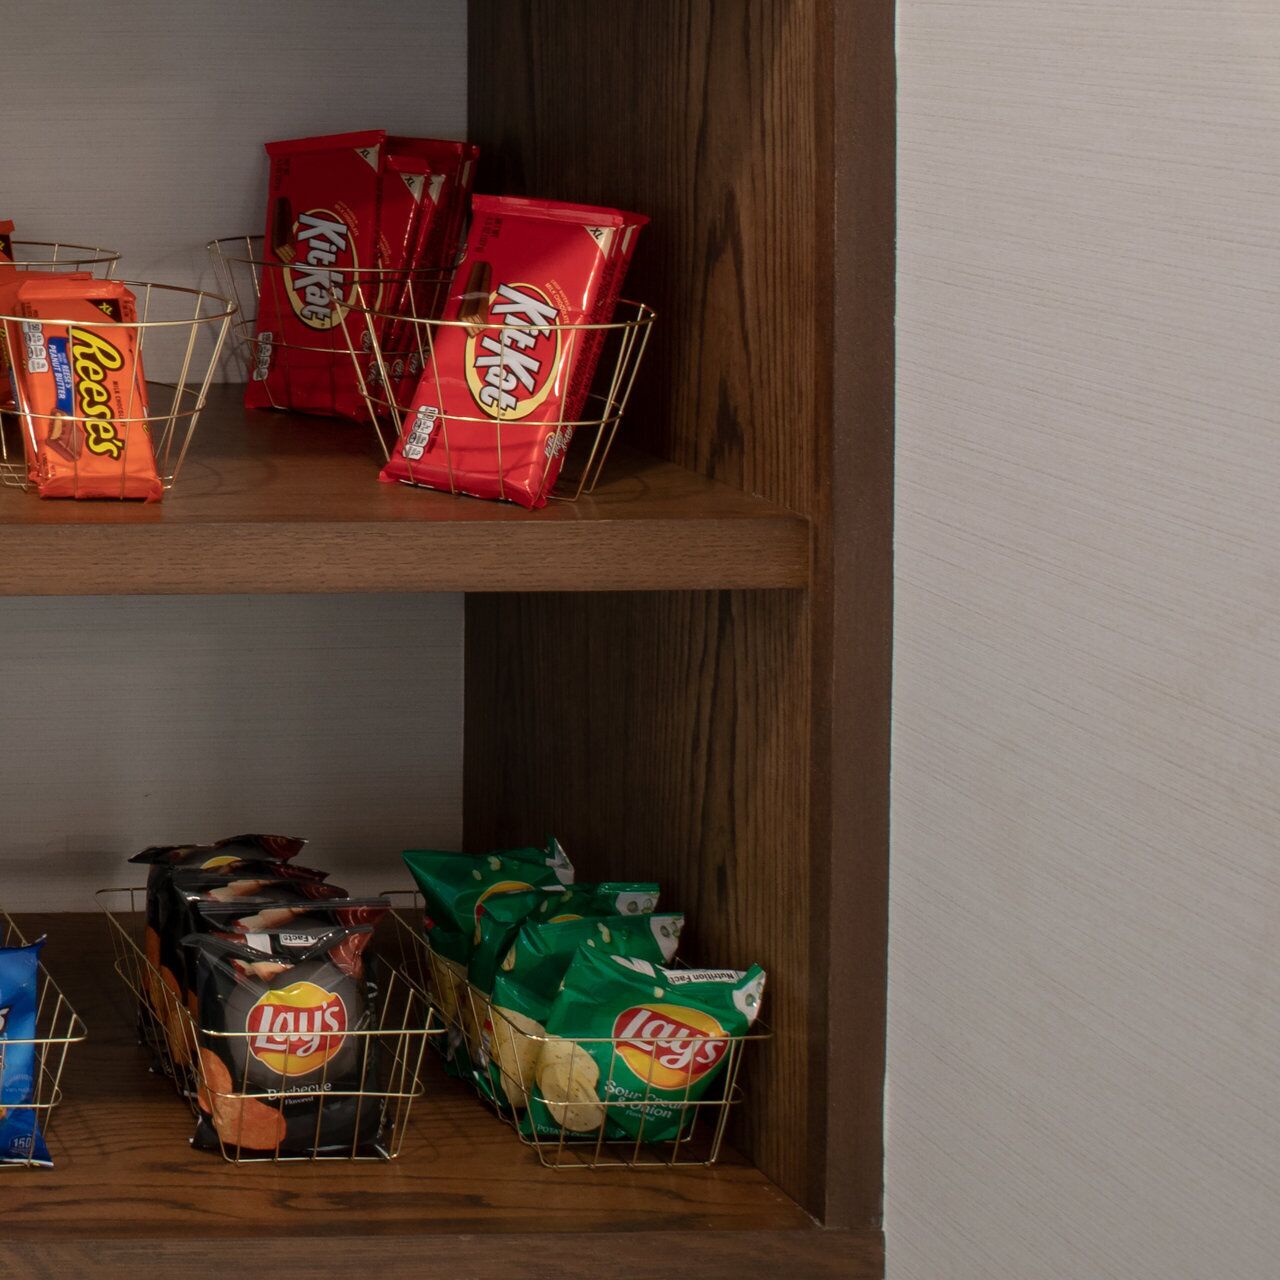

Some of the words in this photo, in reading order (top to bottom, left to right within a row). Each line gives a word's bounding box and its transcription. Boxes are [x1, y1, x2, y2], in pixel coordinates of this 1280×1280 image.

[297, 213, 349, 269] Kit
[590, 226, 603, 240] XL
[99, 301, 114, 316] XL
[293, 260, 345, 323] Kat
[491, 283, 560, 352] Kit
[544, 282, 558, 299] MILK
[552, 293, 570, 325] CHOCOLATE
[48, 344, 59, 372] PEANUT
[54, 372, 67, 400] BUTTER
[70, 326, 125, 459] Reese's
[475, 336, 542, 412] Kat
[692, 968, 735, 982] Nutrition
[255, 1001, 341, 1057] Lay's
[619, 1009, 728, 1070] Lay's
[266, 1081, 332, 1102] Barbecue
[604, 1078, 643, 1099] Sour
[630, 1100, 674, 1120] Onion
